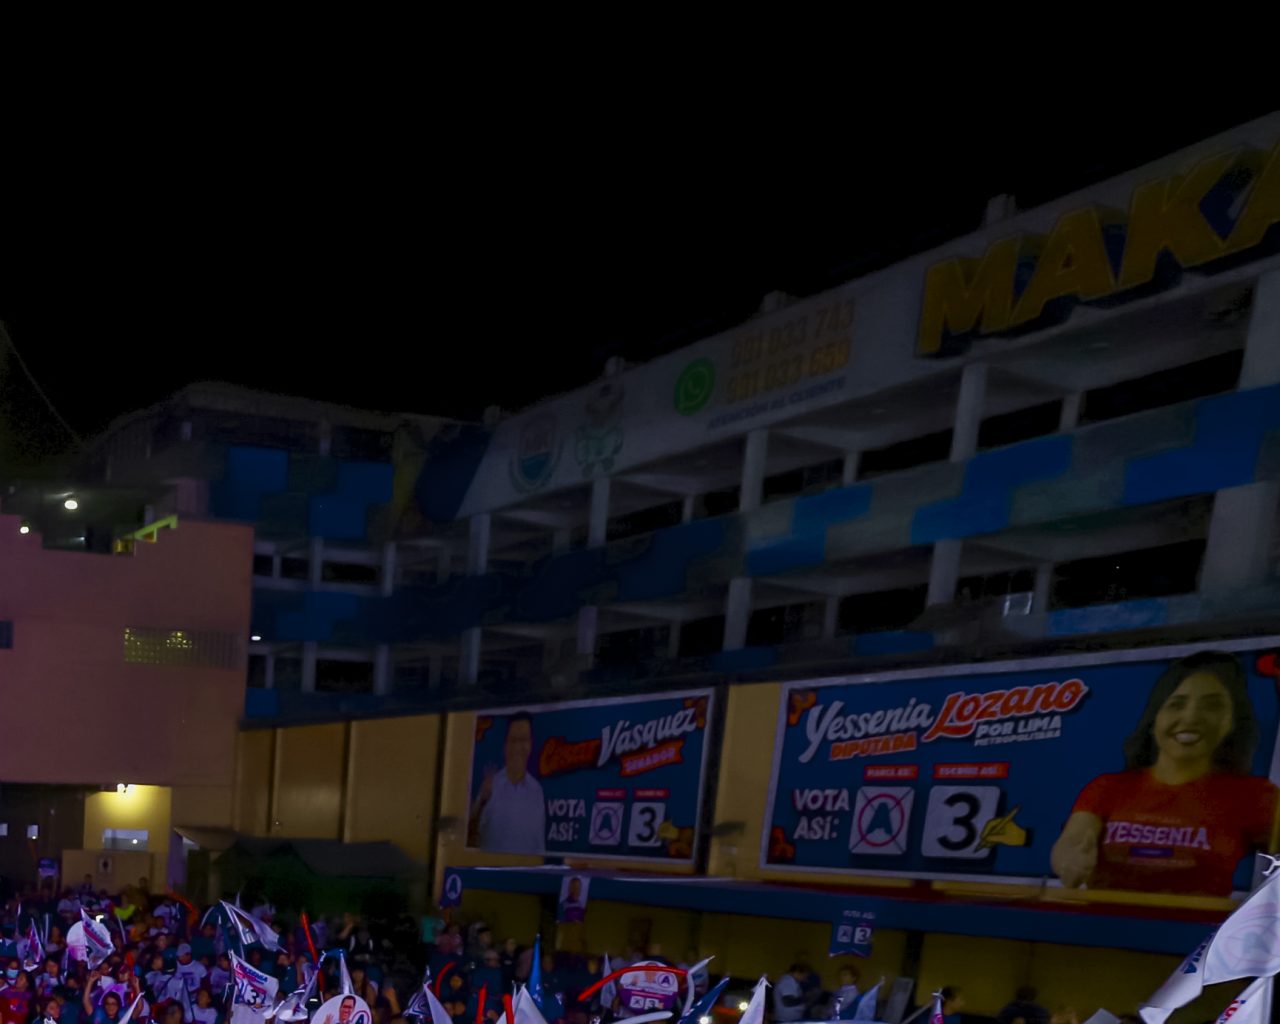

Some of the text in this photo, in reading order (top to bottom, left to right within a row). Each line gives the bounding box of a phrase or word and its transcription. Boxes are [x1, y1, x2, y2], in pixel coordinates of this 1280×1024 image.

[798, 678, 1089, 764] Yessenia Lozano
[978, 715, 1062, 739] POR LIMA
[597, 708, 697, 768] Vásquez
[831, 734, 917, 759] DIPUTADA
[547, 799, 586, 818] VOTA
[791, 787, 850, 811] VOTA
[637, 807, 657, 841] 3
[792, 815, 840, 840] ASÍ:
[937, 793, 980, 851] 3
[1104, 820, 1212, 850] YESSENIA
